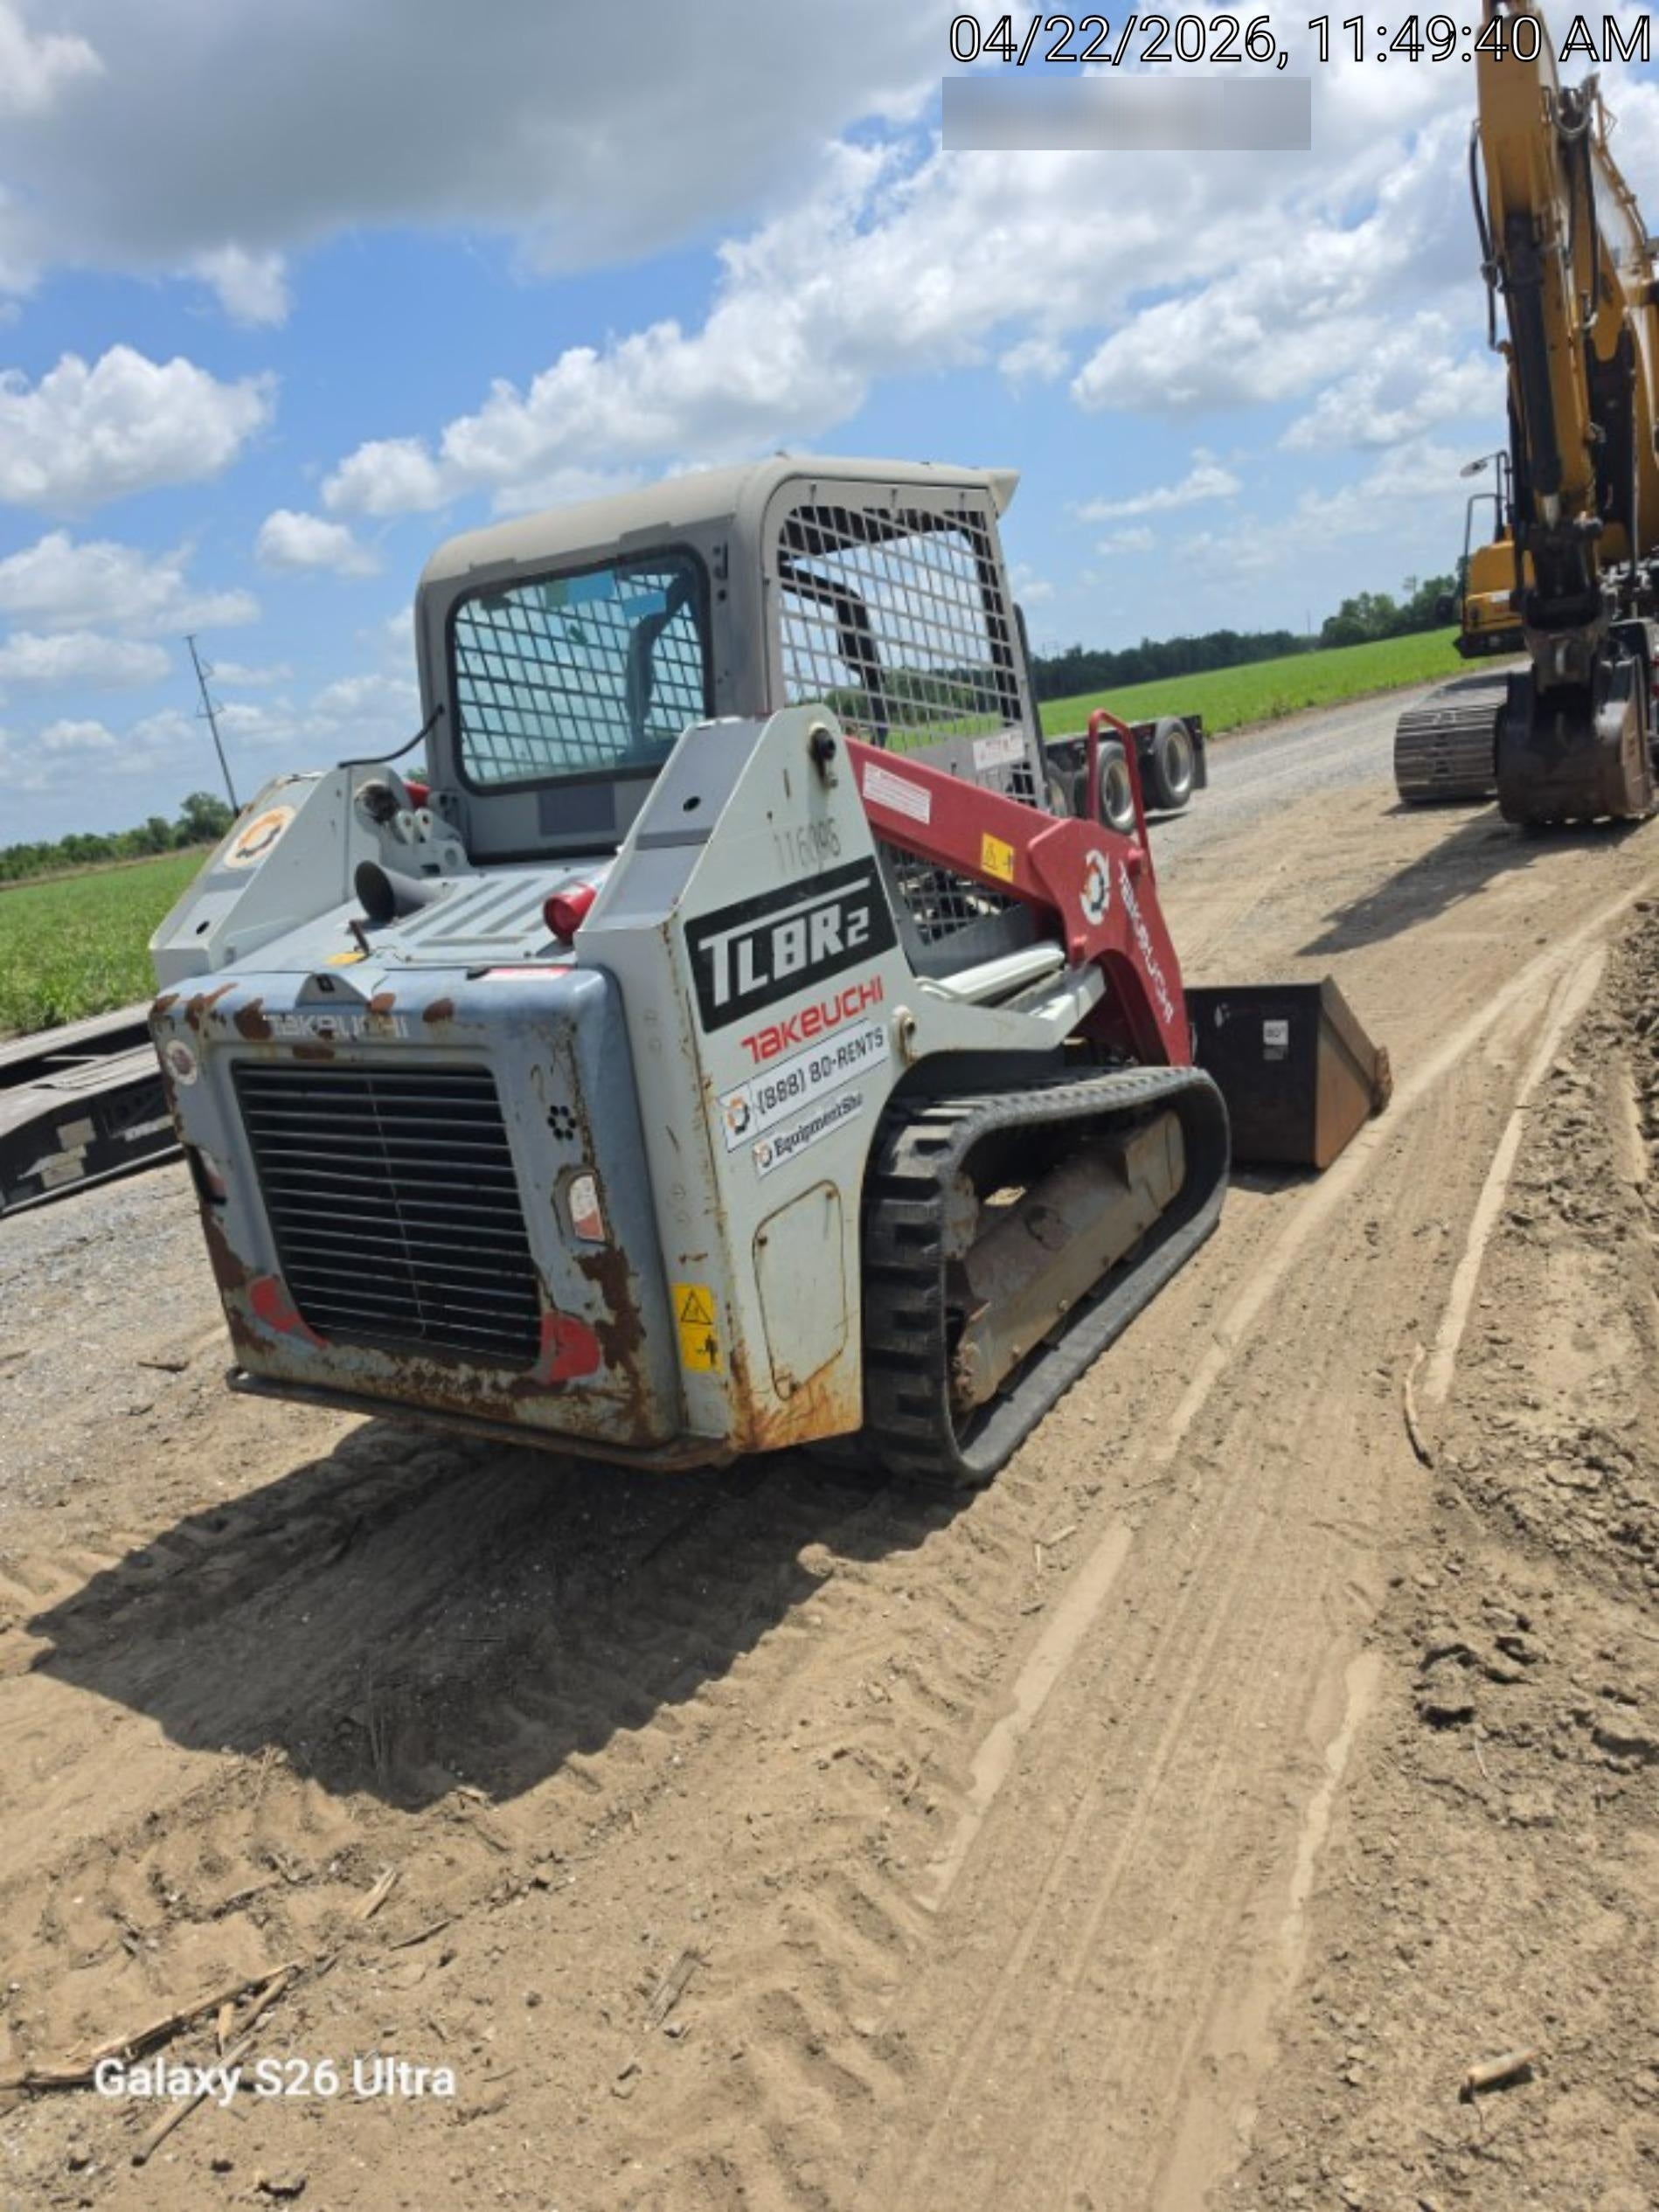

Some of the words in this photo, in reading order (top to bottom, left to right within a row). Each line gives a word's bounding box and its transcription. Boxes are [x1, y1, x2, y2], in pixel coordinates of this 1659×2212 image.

[698, 877, 871, 1008] TL8R2
[262, 1014, 409, 1038] TAKEUHI
[740, 974, 884, 1064] TAKEUCHI
[756, 1068, 806, 1114] (888)
[809, 1026, 884, 1084] 80-RENTS
